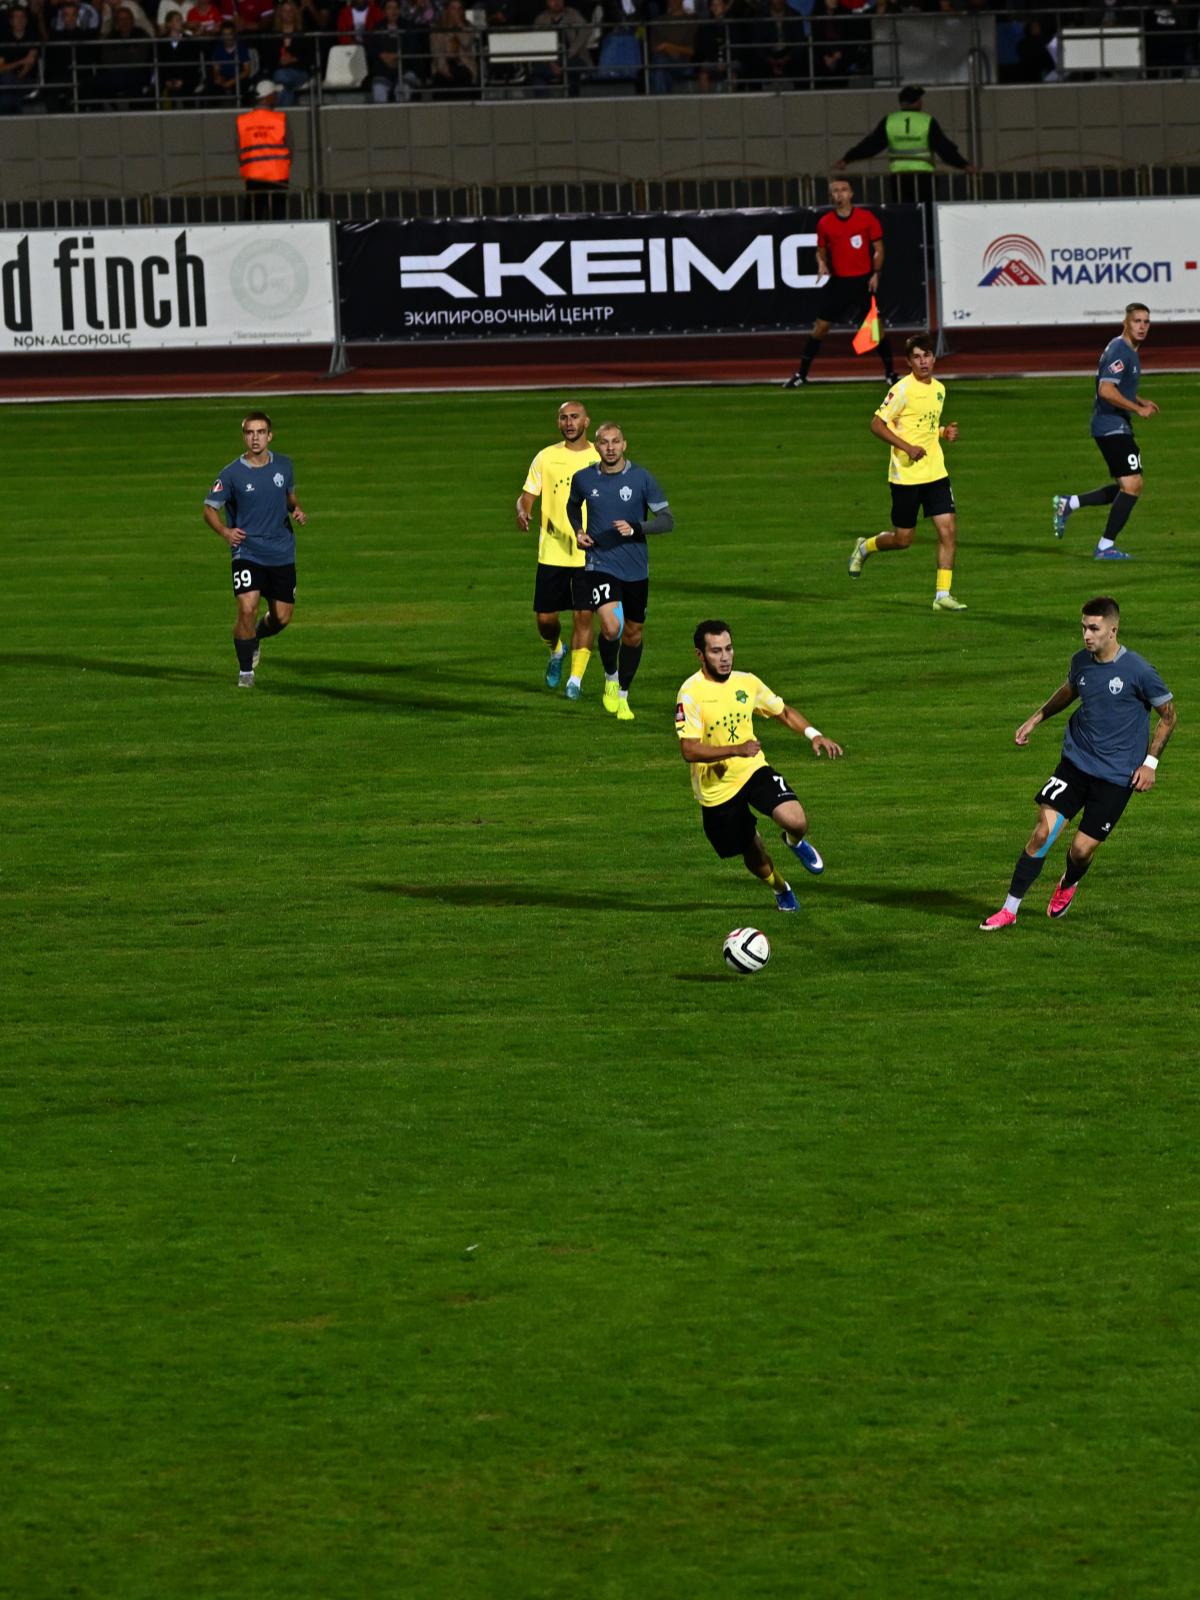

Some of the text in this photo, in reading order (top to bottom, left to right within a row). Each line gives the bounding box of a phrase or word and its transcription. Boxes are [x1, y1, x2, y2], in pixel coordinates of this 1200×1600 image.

[1051, 246, 1133, 262] ГОВОРИТ
[53, 229, 208, 332] finch
[1051, 262, 1172, 286] МАЙКОП
[404, 304, 614, 326] ЭКИПИРОВОЧНЫЙ ЦЕНТР
[952, 309, 972, 321] 12+
[13, 332, 132, 348] NON-ALCOHOLIC
[1127, 453, 1143, 470] 9
[233, 569, 252, 590] 59
[592, 583, 611, 605] 97
[772, 775, 787, 792] 7
[1041, 775, 1068, 801] 77
